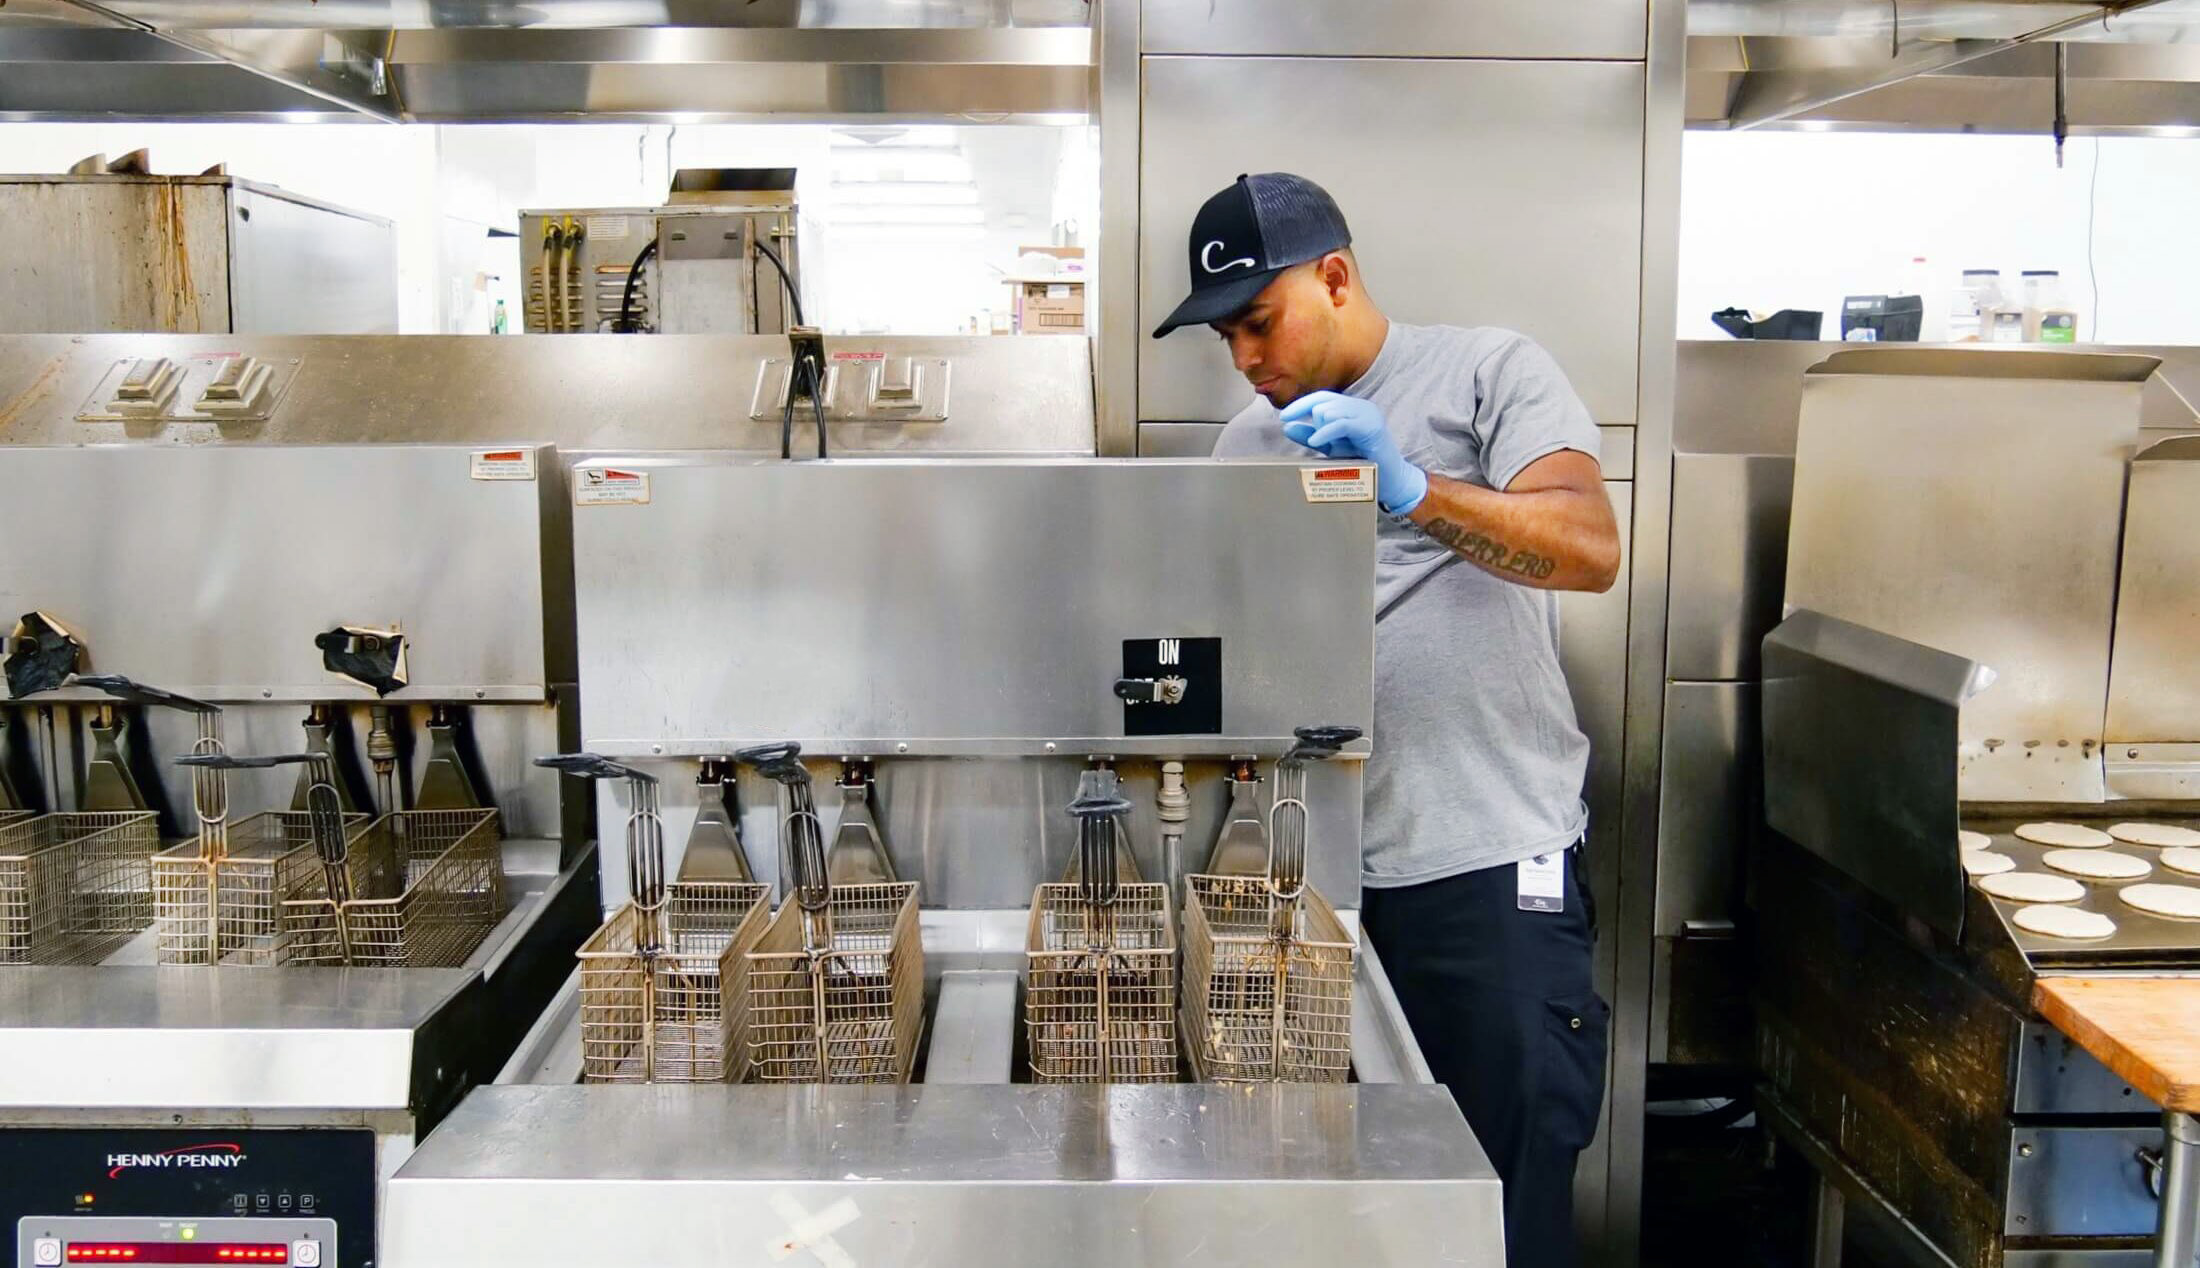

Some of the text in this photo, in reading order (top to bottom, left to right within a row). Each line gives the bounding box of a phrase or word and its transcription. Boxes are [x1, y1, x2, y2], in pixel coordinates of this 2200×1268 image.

[1158, 638, 1180, 665] ON
[107, 1154, 242, 1167] HENNY PENNY
